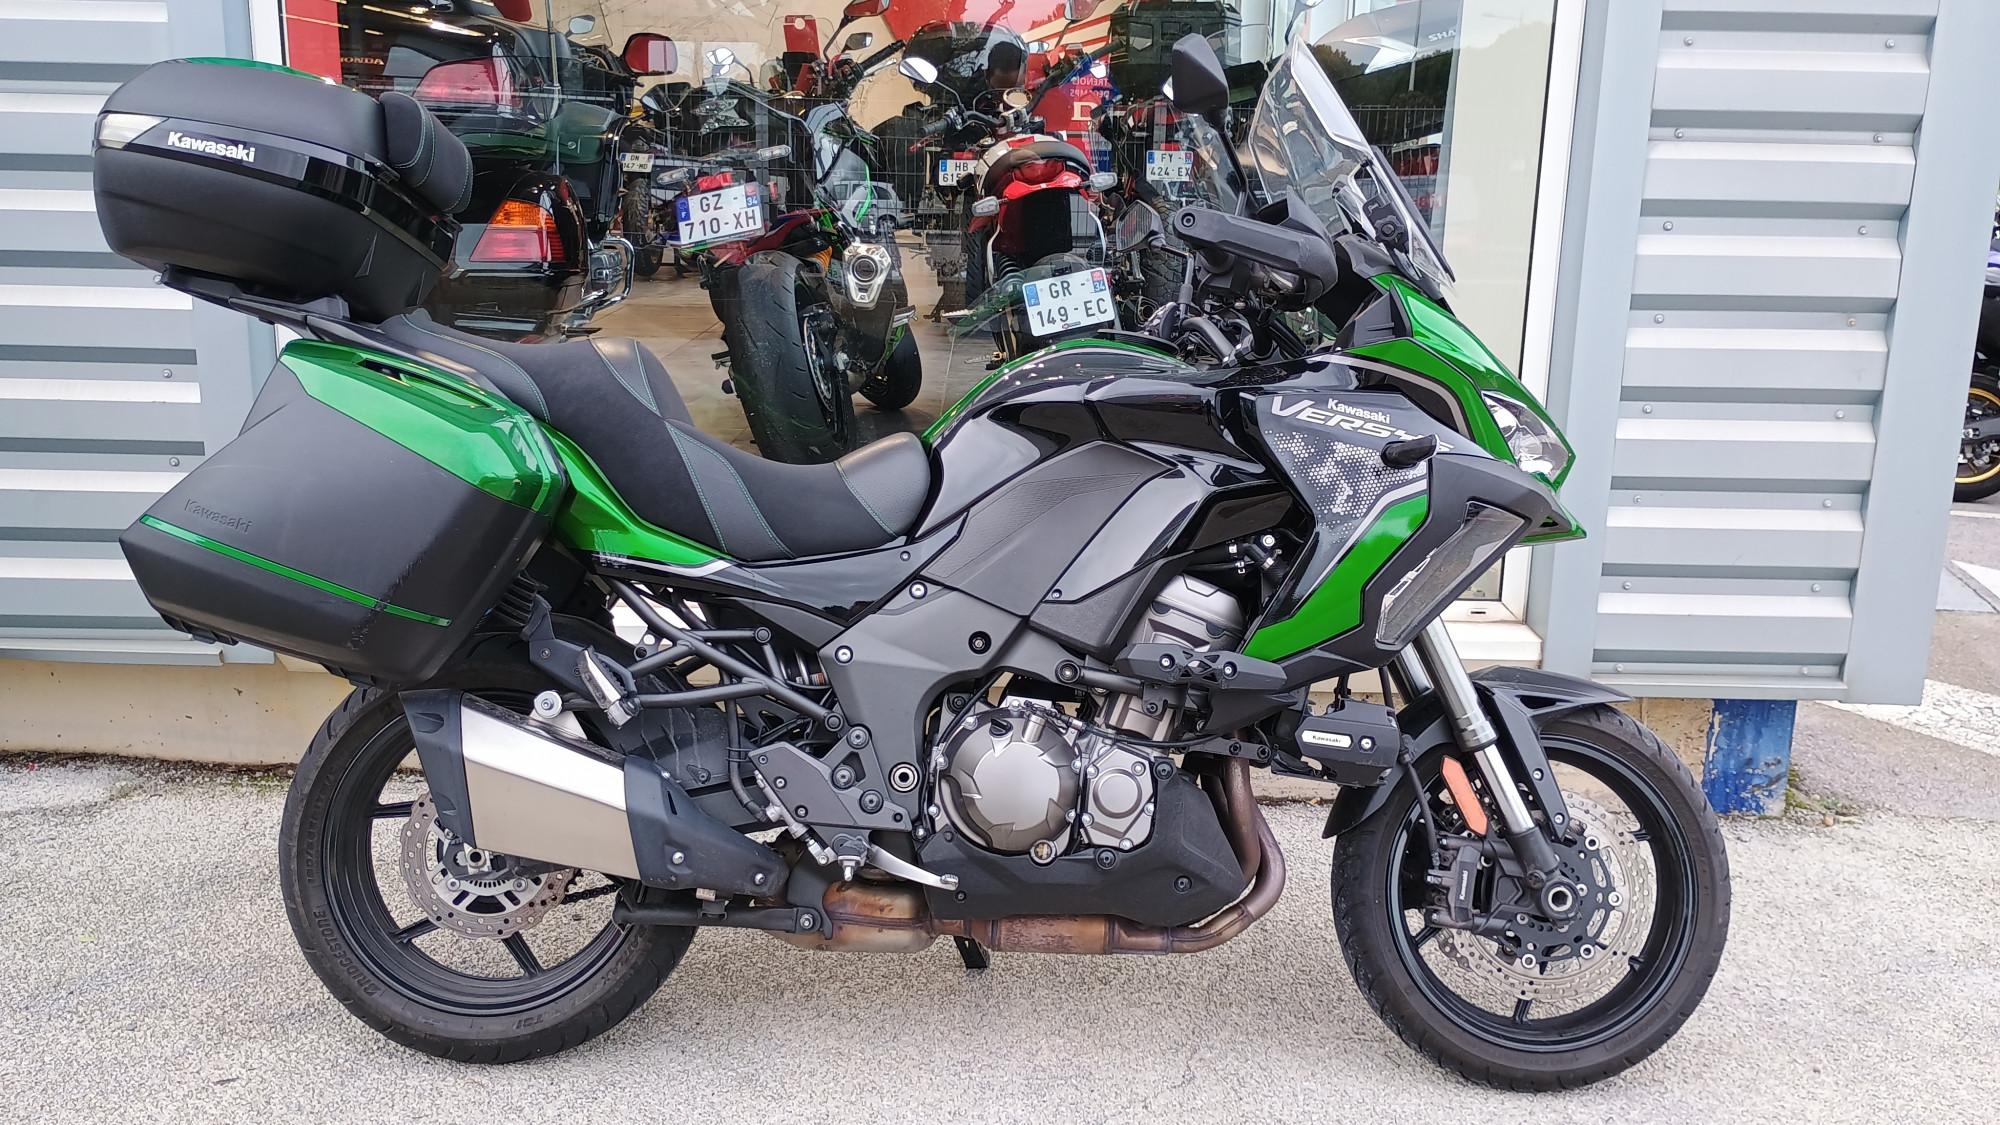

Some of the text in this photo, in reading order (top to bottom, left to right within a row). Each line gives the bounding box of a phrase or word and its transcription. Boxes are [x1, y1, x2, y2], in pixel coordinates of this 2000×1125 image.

[167, 131, 255, 162] Kawasaki
[1161, 153, 1173, 163] FY
[954, 161, 969, 171] HB
[699, 192, 724, 213] GZ
[746, 196, 758, 206] 34
[681, 211, 687, 219] F
[684, 209, 757, 240] 710-XH
[1048, 280, 1073, 299] GR
[1093, 281, 1106, 292] 34
[1031, 298, 1036, 306] F
[1327, 397, 1391, 425] Kawasaki
[184, 498, 253, 534] Kawasaki
[1312, 734, 1342, 744] Kawasaki
[312, 908, 381, 997] BRIDGESTONE
